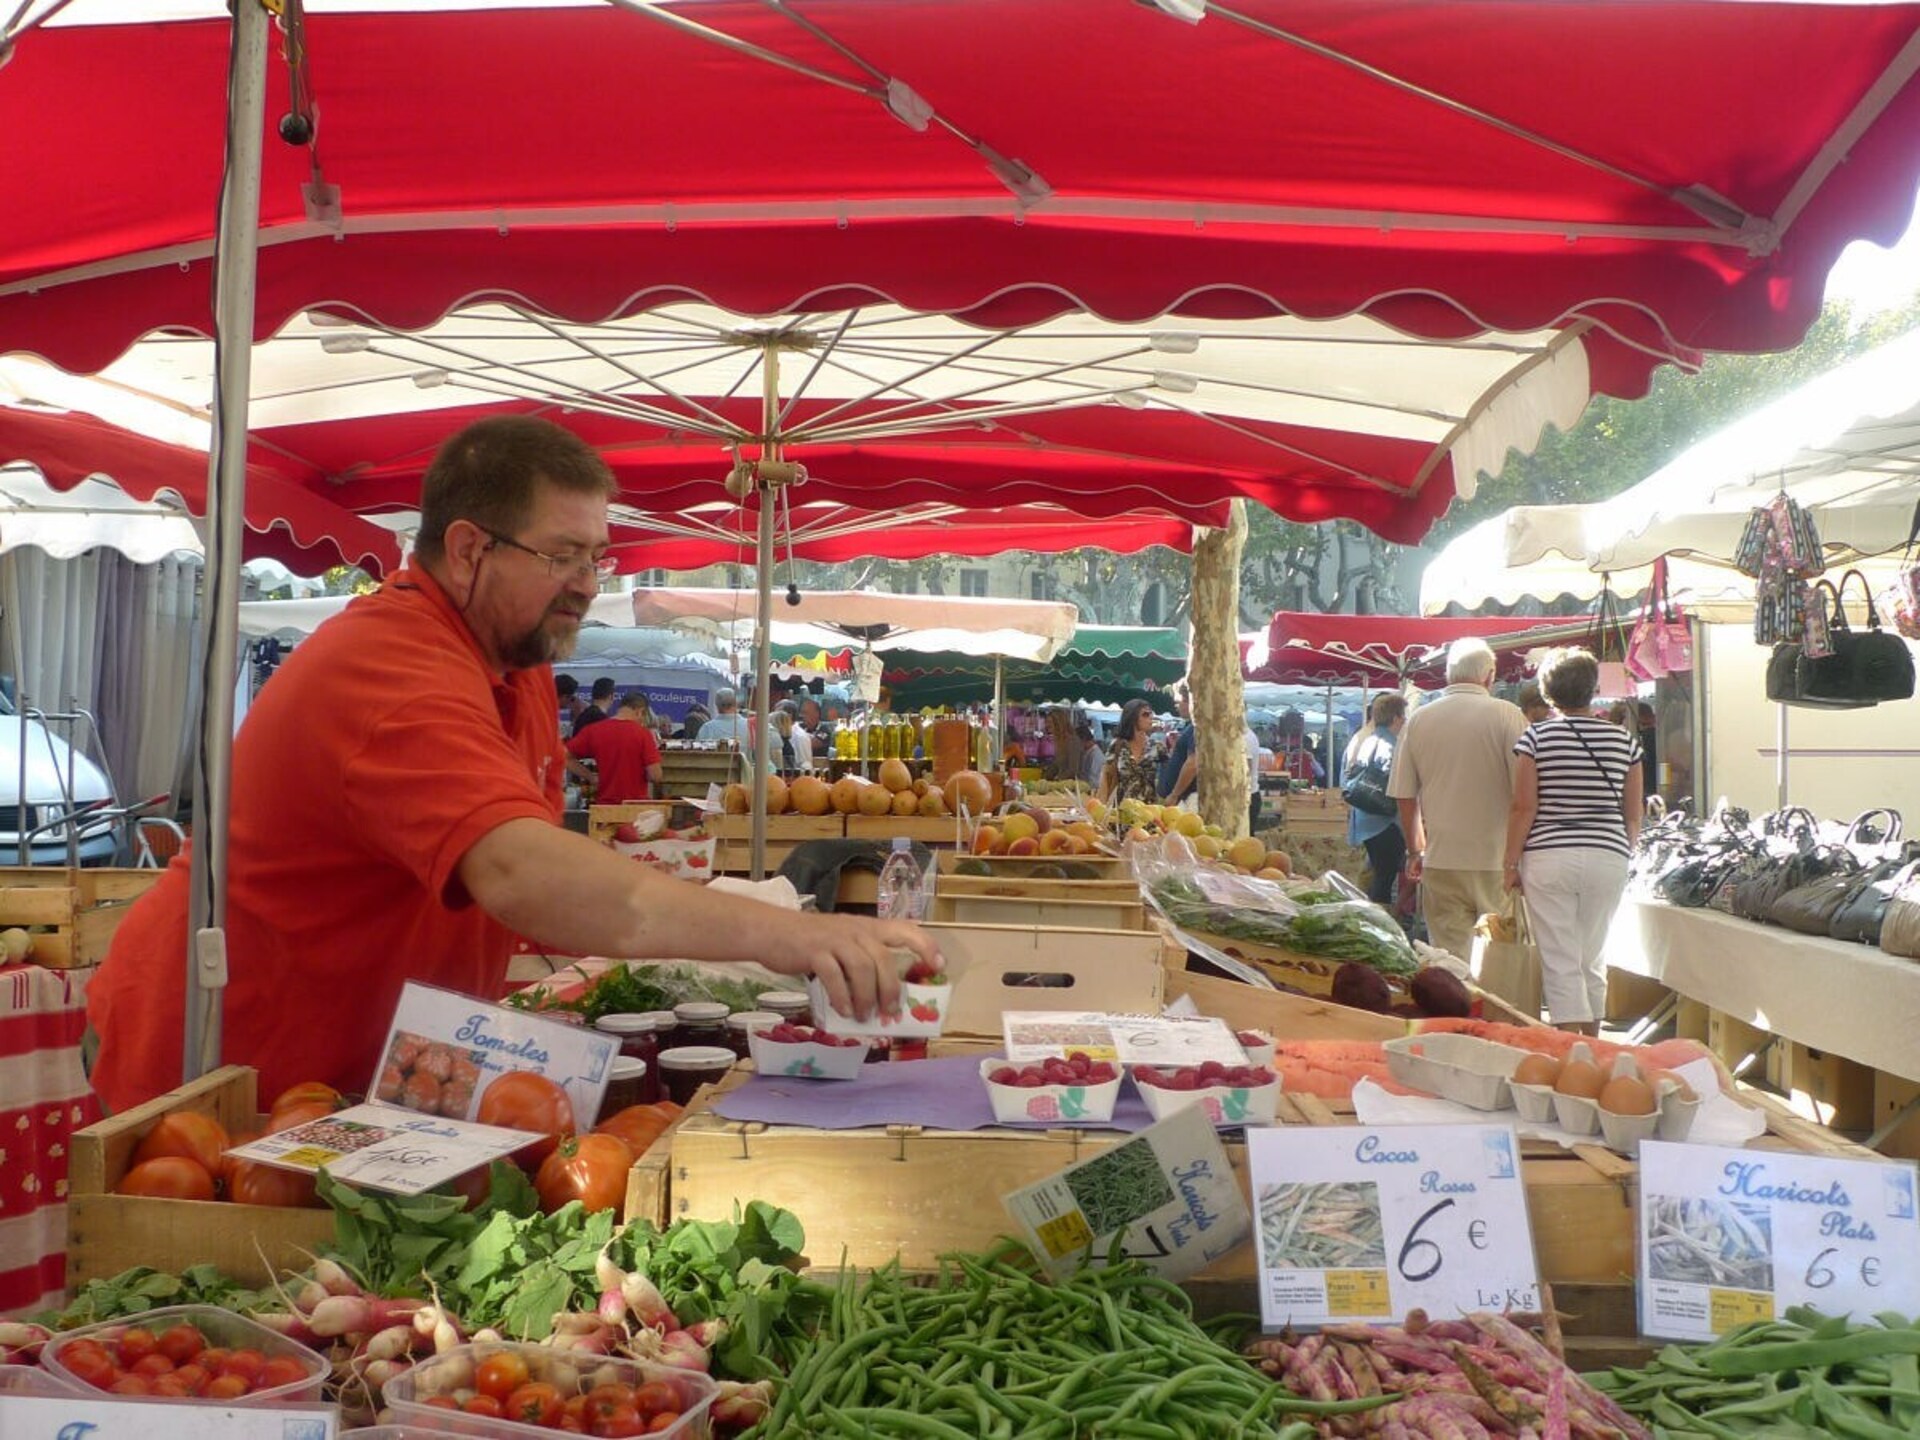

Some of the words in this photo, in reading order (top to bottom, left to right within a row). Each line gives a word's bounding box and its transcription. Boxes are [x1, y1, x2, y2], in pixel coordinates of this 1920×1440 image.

[651, 691, 698, 705] couleurs
[455, 1014, 549, 1063] Tomates
[1128, 1031, 1158, 1047] 6
[1355, 1135, 1420, 1163] Cocos
[1172, 1160, 1220, 1232] Haricots
[1420, 1170, 1477, 1193] Roses
[1718, 1161, 1851, 1206] Haricots
[1398, 1198, 1456, 1281] 6
[1468, 1219, 1488, 1250] €
[1819, 1211, 1877, 1241] Plats
[1804, 1248, 1839, 1289] 6
[1860, 1256, 1882, 1287] €
[1477, 1289, 1500, 1306] Le
[1506, 1288, 1534, 1309] Kg
